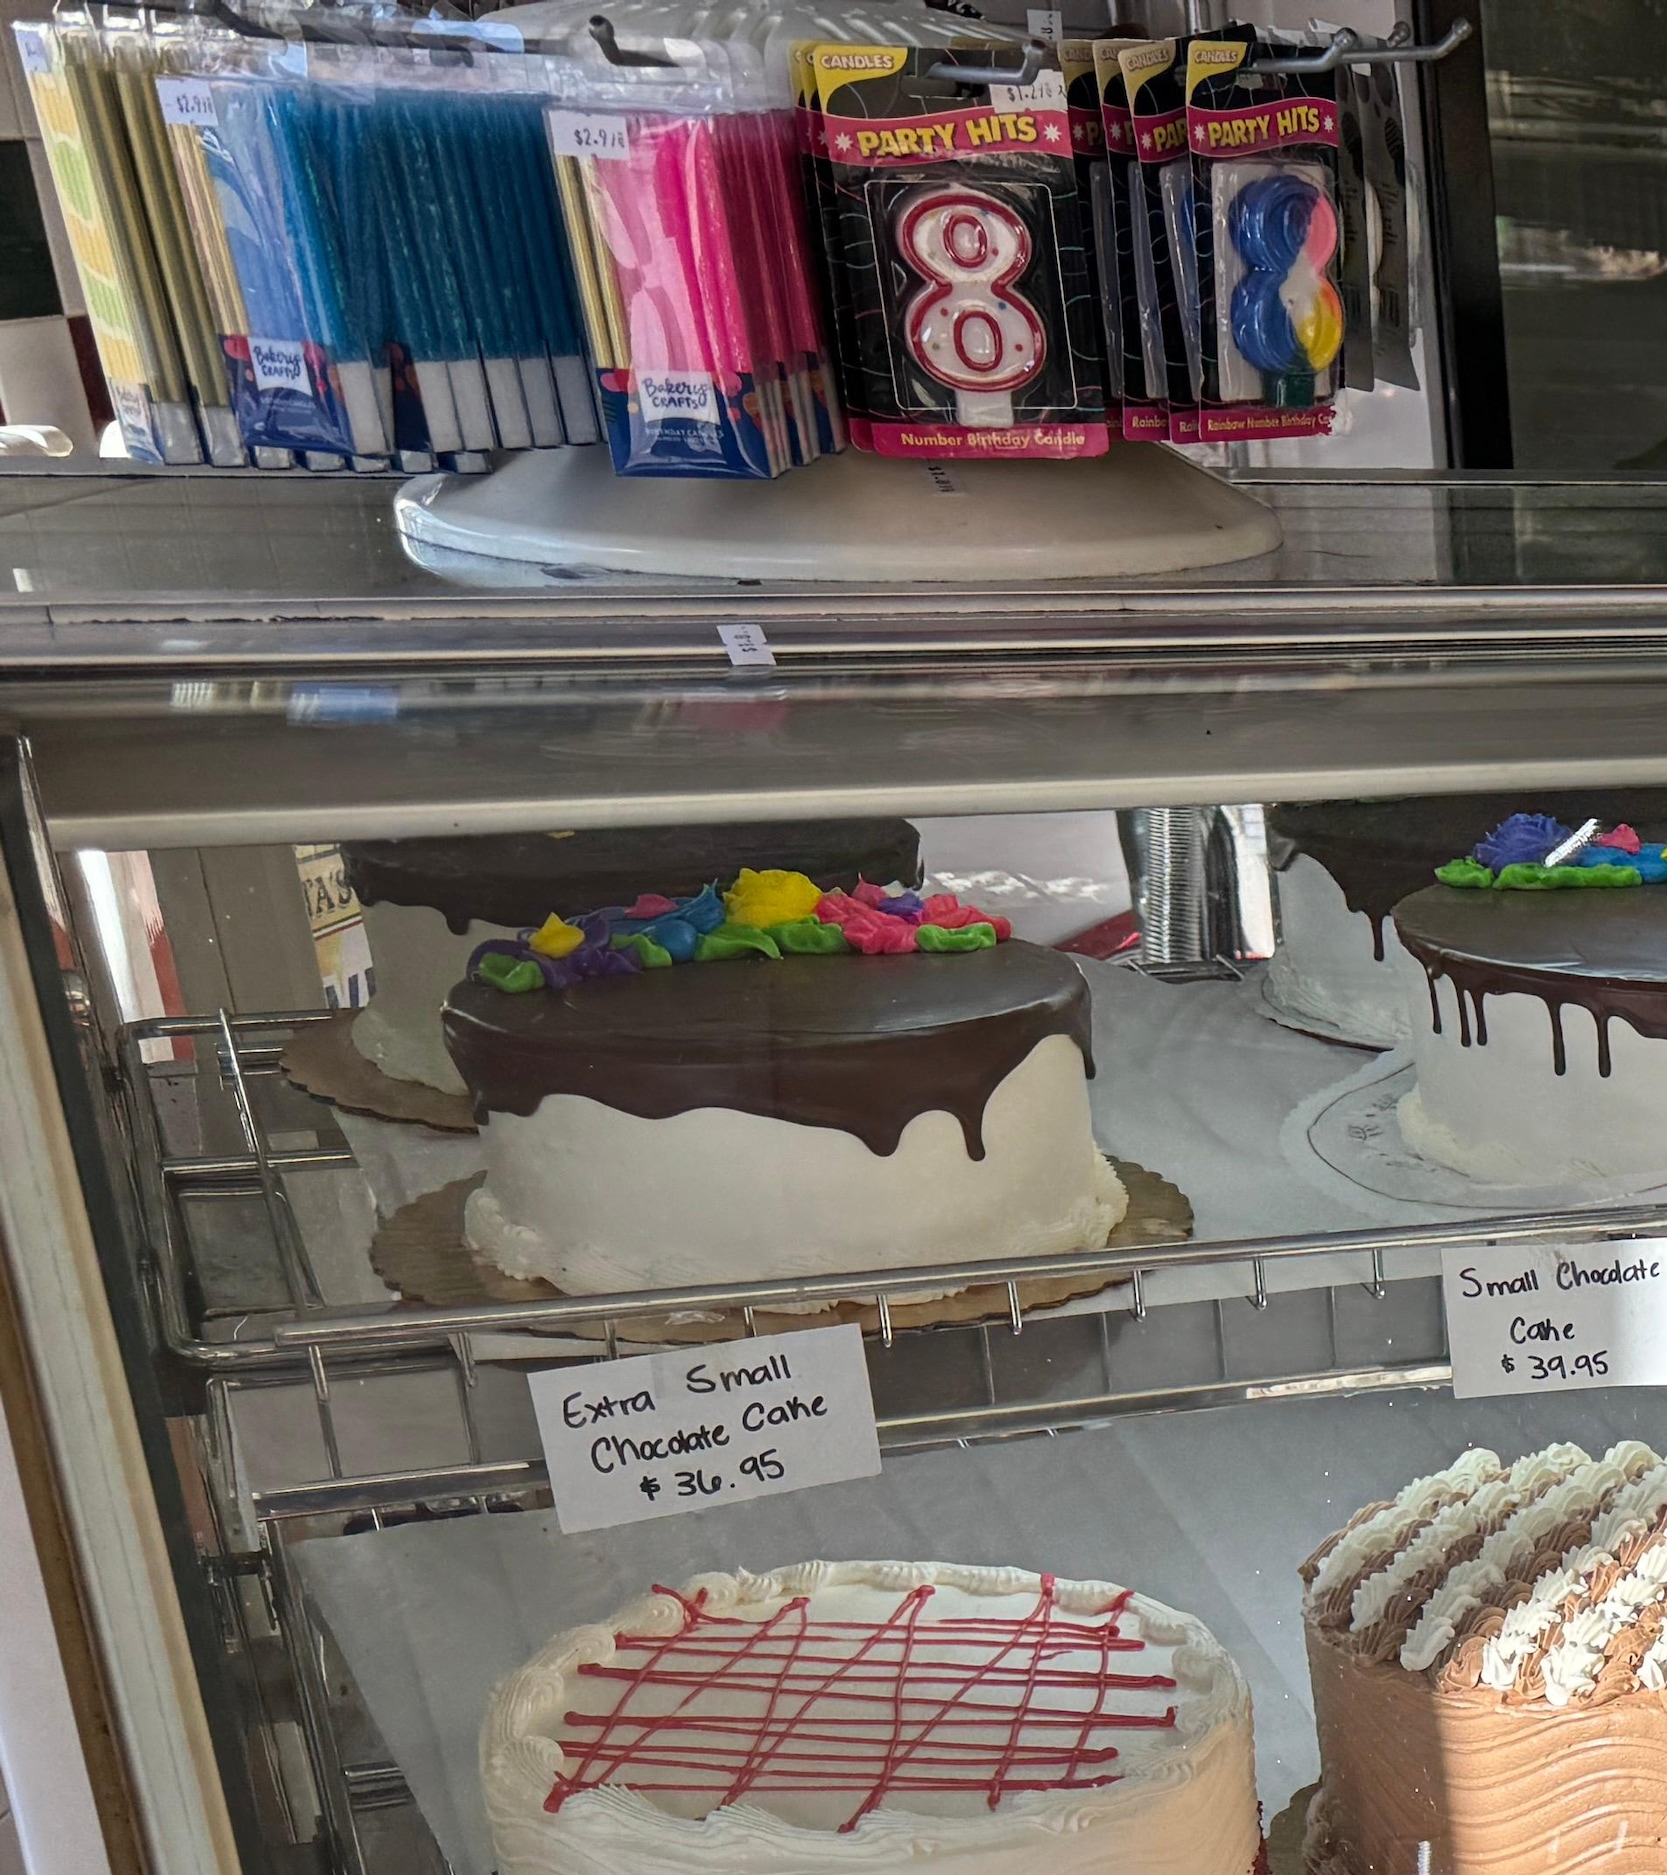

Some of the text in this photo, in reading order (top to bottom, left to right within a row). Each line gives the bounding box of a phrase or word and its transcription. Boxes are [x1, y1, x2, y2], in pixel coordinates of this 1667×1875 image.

[820, 54, 894, 69] CANDLES
[1126, 50, 1169, 71] CANDLES
[1194, 52, 1236, 63] CANDLES
[857, 114, 1037, 158] PARTY HITS
[1153, 119, 1186, 152] PAR
[1208, 105, 1320, 148] PARTY HITS
[642, 377, 711, 402] Bakery
[652, 396, 700, 410] CRAFTS
[1206, 417, 1244, 432] Rainbow
[1246, 415, 1279, 430] Number
[1281, 412, 1317, 430] Birthday
[901, 430, 1086, 449] Number Birthday Candle
[1459, 1258, 1660, 1298] Small Chocolate
[1510, 1316, 1576, 1345] Cake
[562, 1353, 792, 1429] Extra Small
[590, 1394, 828, 1474] Chocolate Cake
